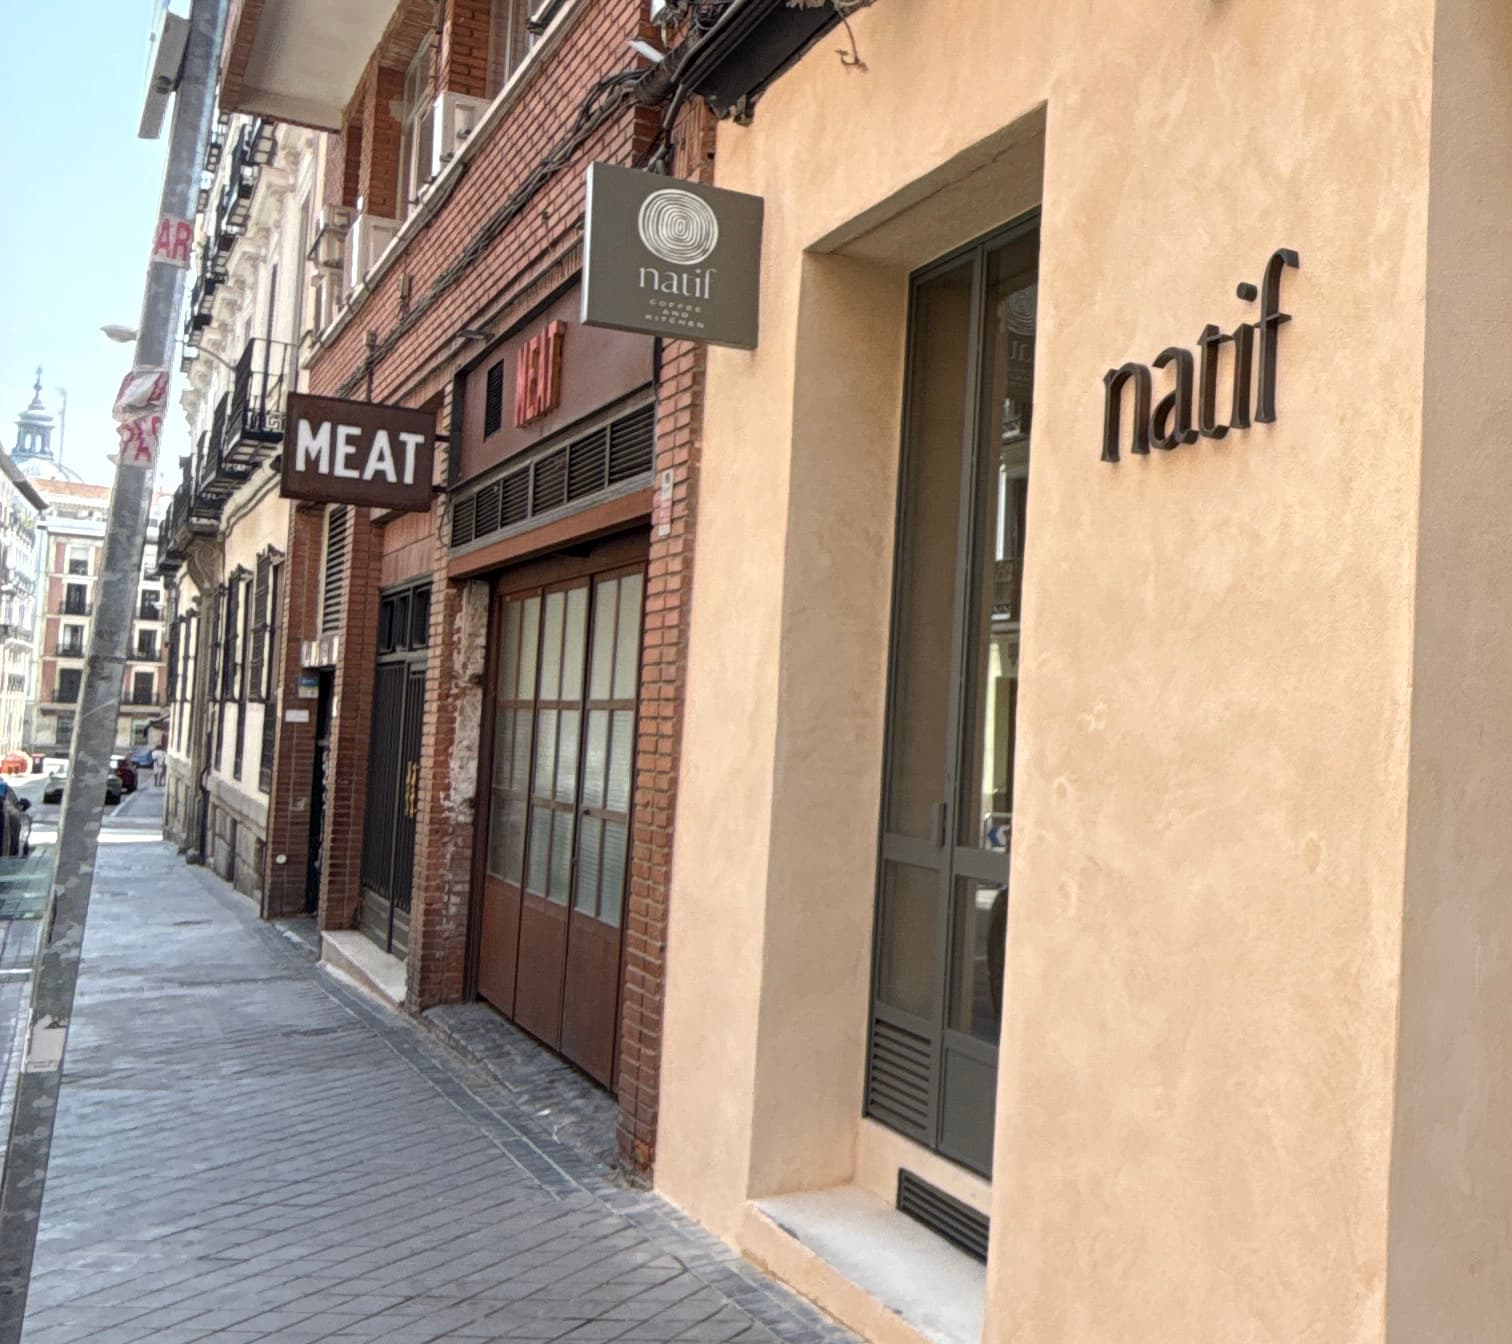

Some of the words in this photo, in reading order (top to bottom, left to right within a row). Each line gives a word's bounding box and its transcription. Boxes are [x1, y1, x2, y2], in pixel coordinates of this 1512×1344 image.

[638, 267, 718, 299] natif
[645, 314, 705, 329] KITCHEN
[649, 299, 702, 313] COFFEE
[662, 309, 690, 319] AND
[1101, 247, 1300, 463] natif
[513, 320, 568, 429] MEAT
[295, 419, 425, 485] MEAT
